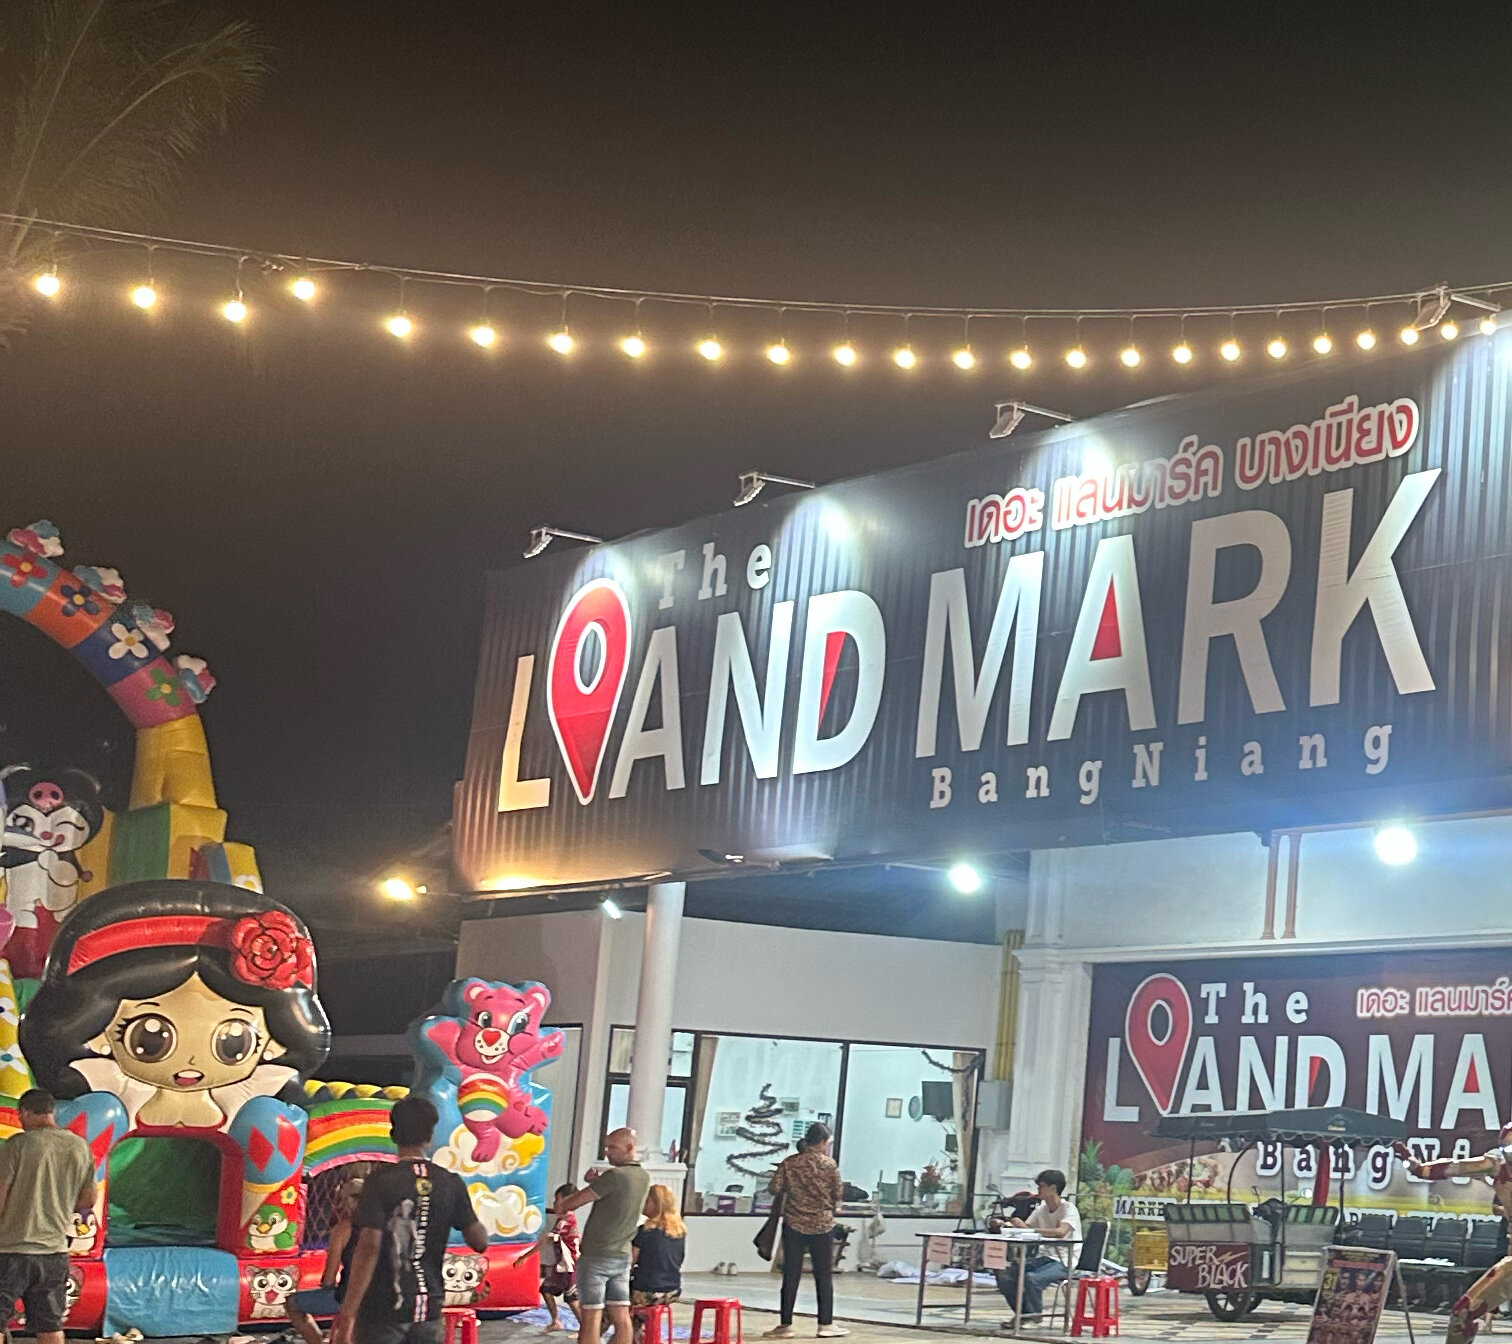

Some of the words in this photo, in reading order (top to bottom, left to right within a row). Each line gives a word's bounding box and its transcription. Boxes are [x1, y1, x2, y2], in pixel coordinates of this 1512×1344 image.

[1236, 397, 1419, 488] บางเนียง
[656, 542, 772, 610] The
[498, 590, 886, 813] LAND
[914, 467, 1443, 759] MARK
[1200, 982, 1309, 1024] The
[1357, 988, 1409, 1017] เดอะ
[1103, 1034, 1345, 1122] LAND
[1115, 1198, 1174, 1218] MARKE
[1169, 1245, 1218, 1266] SUPER
[1197, 1260, 1249, 1289] BLACK
